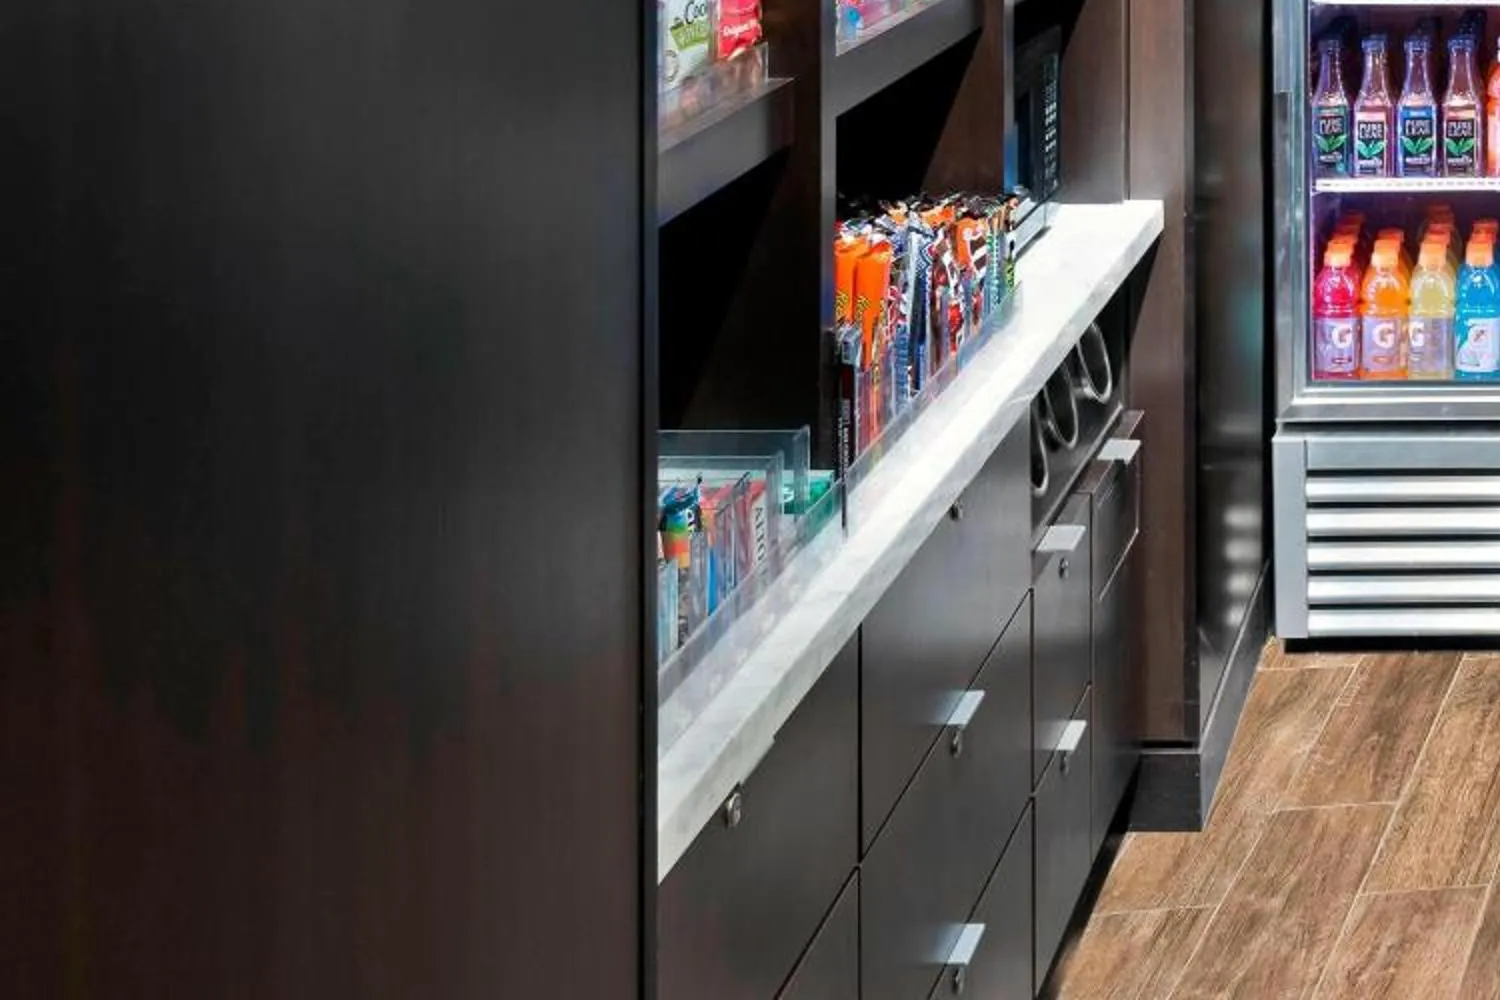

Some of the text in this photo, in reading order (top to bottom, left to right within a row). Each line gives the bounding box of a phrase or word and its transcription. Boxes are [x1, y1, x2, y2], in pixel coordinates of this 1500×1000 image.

[1331, 323, 1353, 349] G
[1372, 322, 1396, 348] G
[1409, 321, 1425, 347] G
